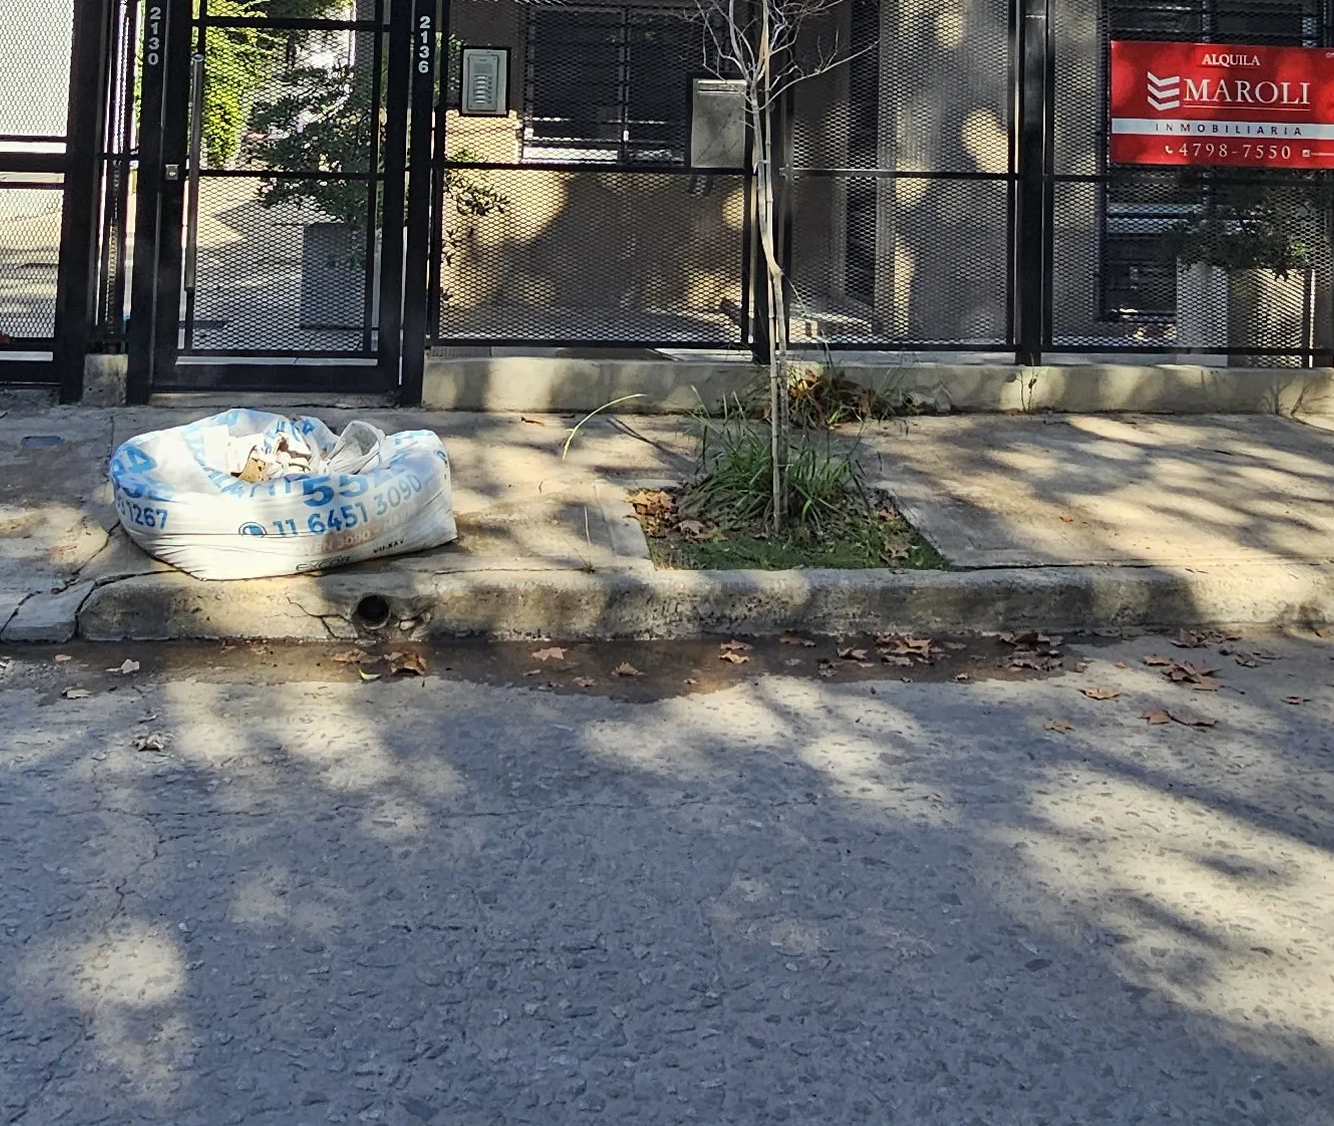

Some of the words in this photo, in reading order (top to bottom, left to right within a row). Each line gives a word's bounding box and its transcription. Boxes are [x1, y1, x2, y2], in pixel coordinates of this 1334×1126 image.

[147, 6, 162, 66] 2130
[418, 15, 431, 74] 2136
[1201, 52, 1261, 67] ALQUILA
[1183, 77, 1311, 105] MAROLI
[1155, 122, 1303, 136] INMOBILIARIA
[1178, 142, 1292, 160] 4798-7550
[272, 518, 299, 535] 11
[307, 501, 368, 534] 6451
[373, 474, 422, 516] 3090
[338, 530, 371, 547] 3090
